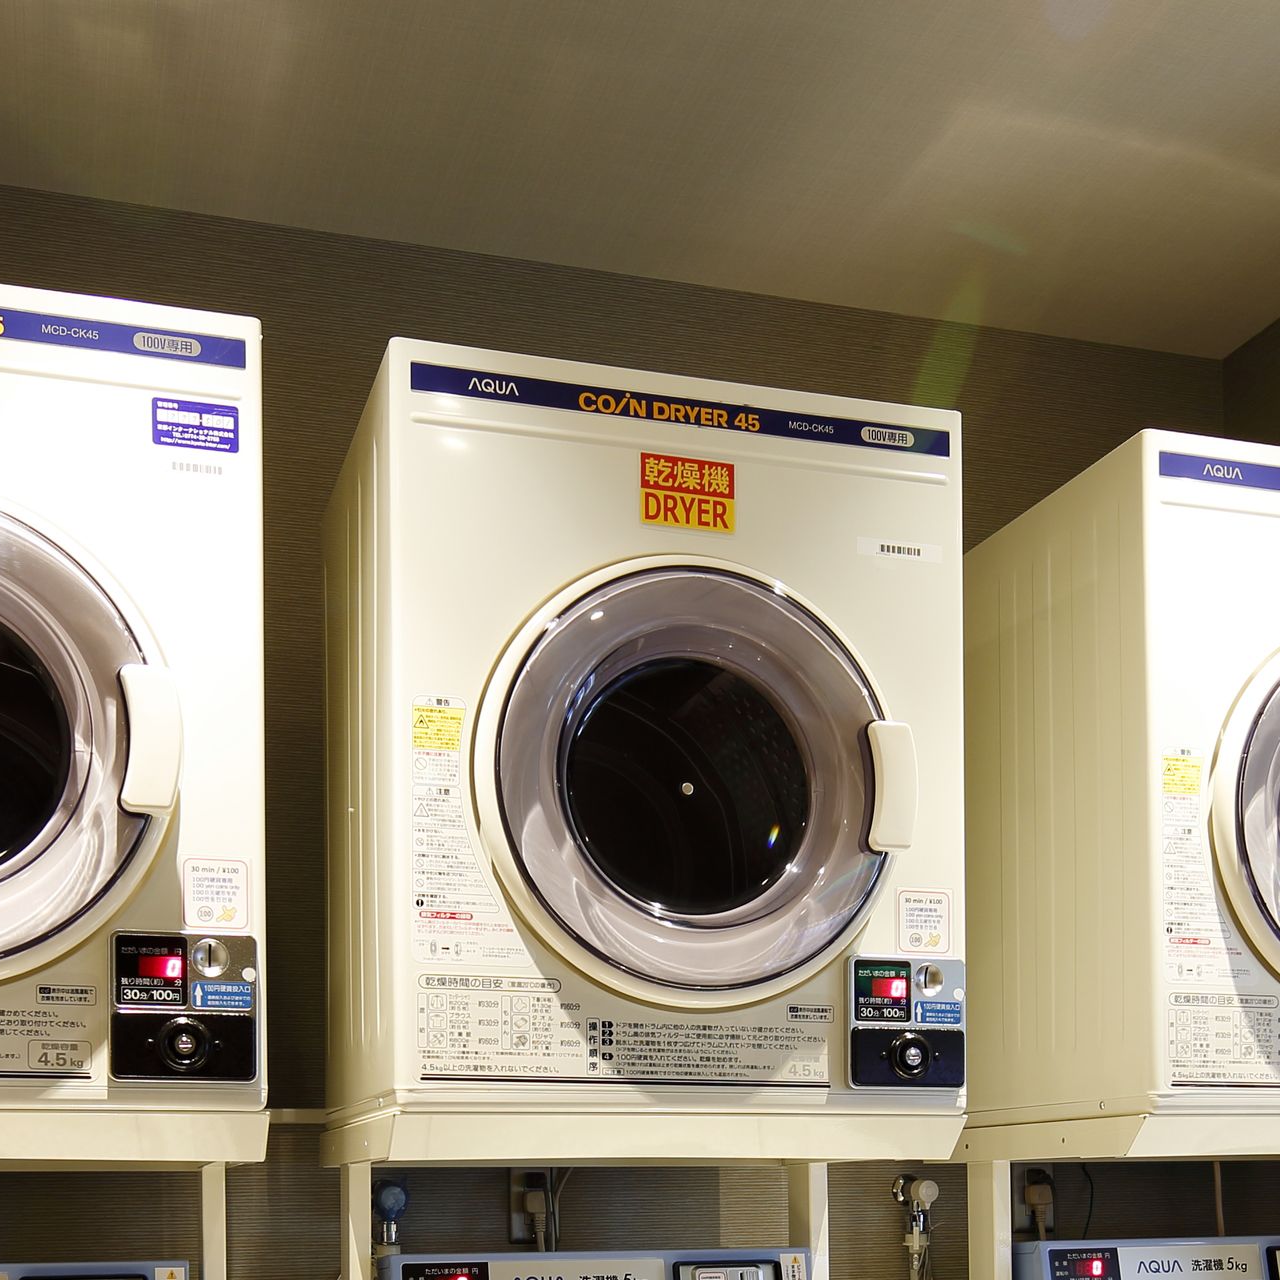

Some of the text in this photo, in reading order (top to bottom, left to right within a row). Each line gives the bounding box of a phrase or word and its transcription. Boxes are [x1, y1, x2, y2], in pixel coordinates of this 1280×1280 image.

[41, 324, 99, 340] MCD-CK45
[141, 335, 193, 354] 100V専用
[468, 377, 519, 397] AQUA
[652, 402, 729, 428] DRYER
[734, 413, 760, 432] 45
[788, 420, 834, 434] MCD-CK45
[867, 429, 908, 445] 100V専用
[644, 456, 730, 496] 乾燥機
[1203, 463, 1243, 480] AQUA
[643, 491, 729, 529] DRYER
[425, 977, 503, 989] 乾燥時間の目安
[123, 989, 180, 1001] 30分/100円
[1174, 995, 1234, 1006] 乾燥時間の目安
[1092, 1260, 1102, 1276] 0
[1137, 1257, 1248, 1274] AQUA 洗濯機 5kg
